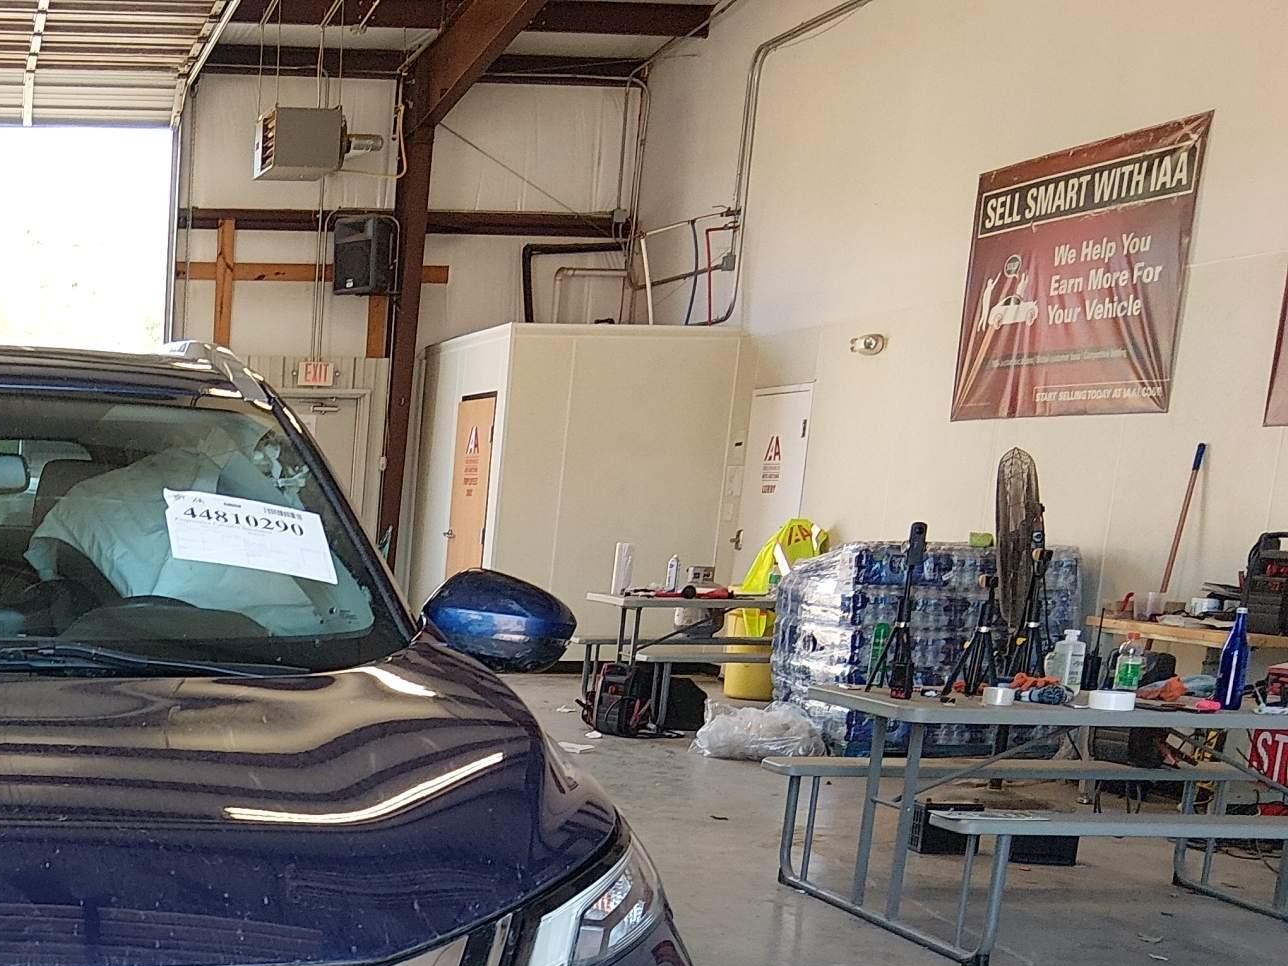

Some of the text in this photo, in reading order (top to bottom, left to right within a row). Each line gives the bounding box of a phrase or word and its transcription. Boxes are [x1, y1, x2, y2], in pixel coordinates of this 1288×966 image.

[984, 151, 1189, 229] SELL SMART WITH IAA
[1054, 233, 1152, 267] We Help You
[1049, 263, 1162, 297] Earn More For
[1047, 294, 1143, 325] Your Vehicle
[304, 362, 330, 383] EXIT
[183, 506, 304, 537] 44810290
[1257, 731, 1288, 782] ST
